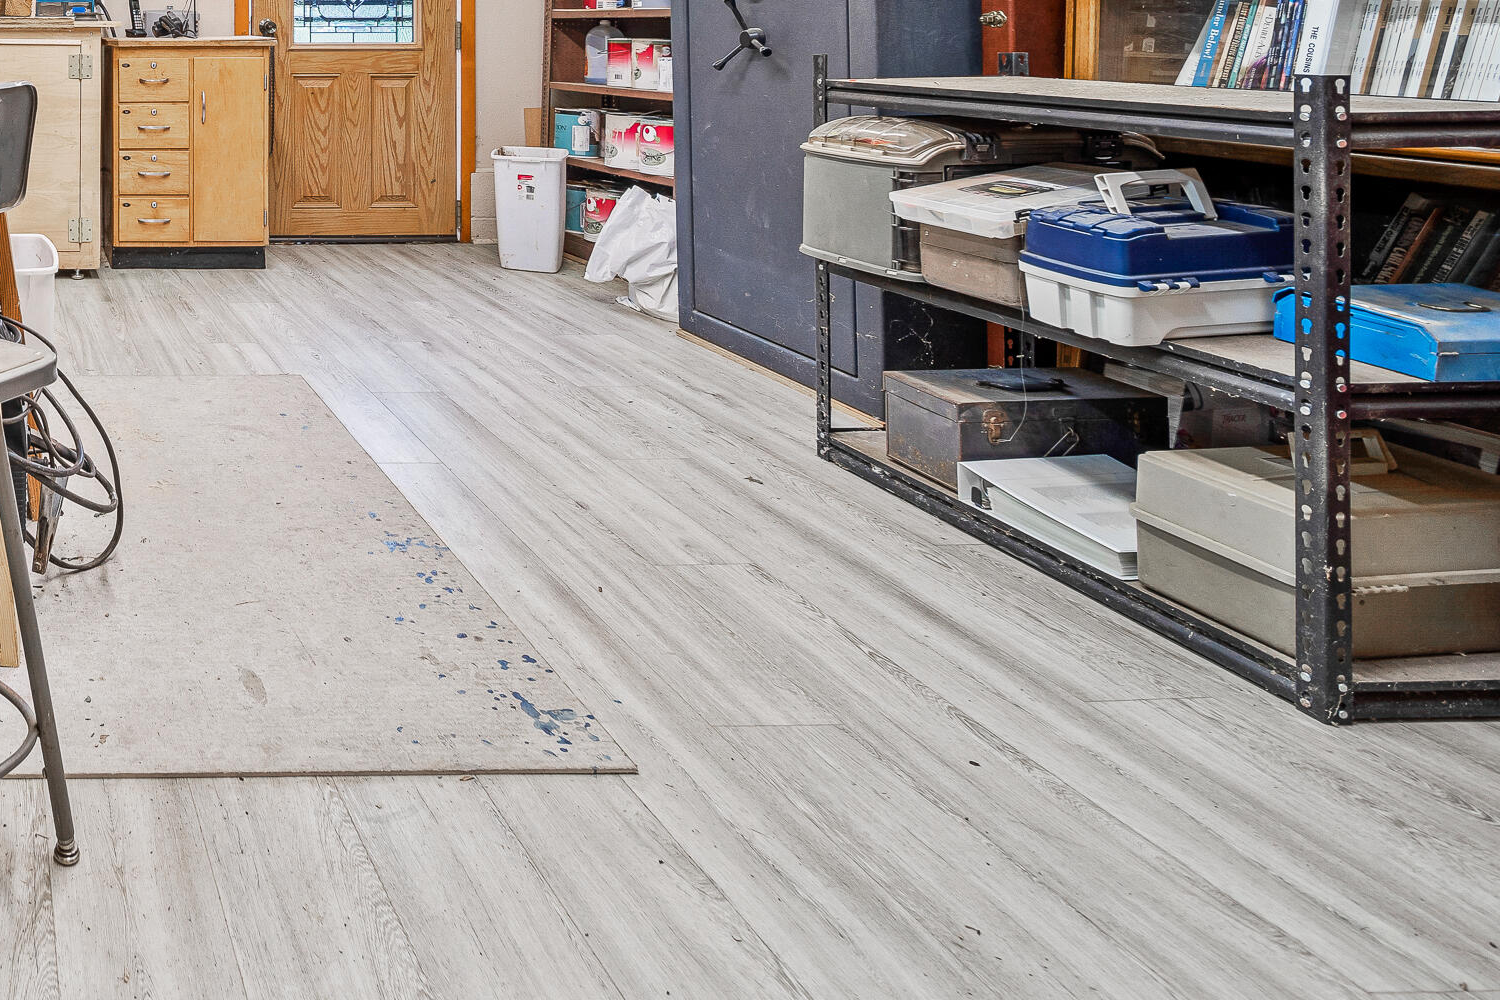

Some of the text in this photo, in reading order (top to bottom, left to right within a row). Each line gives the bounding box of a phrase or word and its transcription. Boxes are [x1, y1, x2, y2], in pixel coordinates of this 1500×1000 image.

[1202, 28, 1219, 59] Below!
[1260, 15, 1274, 42] DESIRE
[1303, 26, 1319, 73] THE COUSINS
